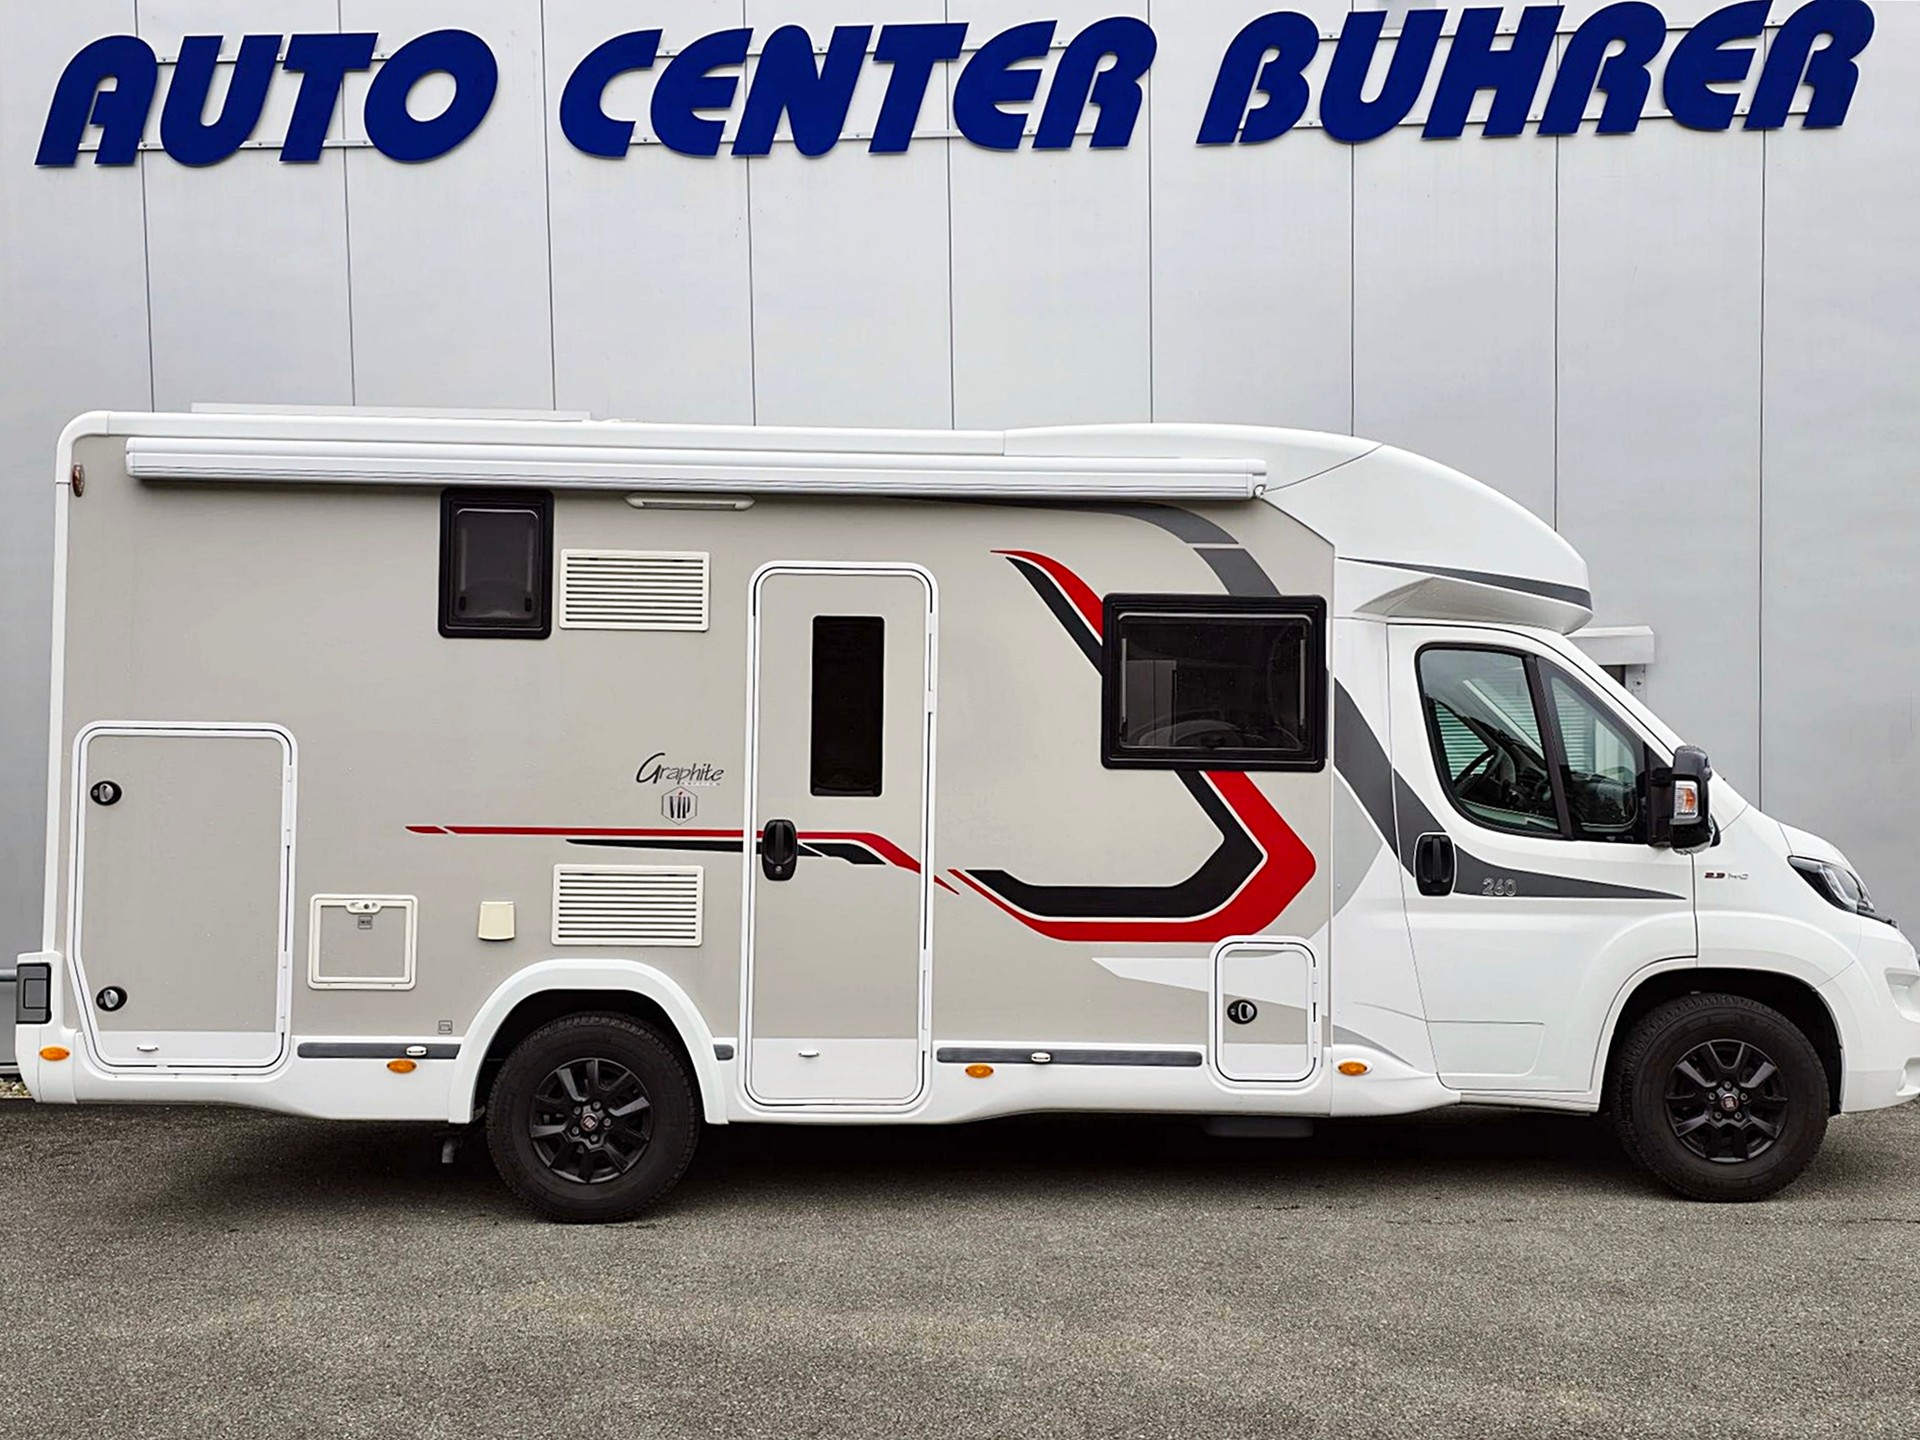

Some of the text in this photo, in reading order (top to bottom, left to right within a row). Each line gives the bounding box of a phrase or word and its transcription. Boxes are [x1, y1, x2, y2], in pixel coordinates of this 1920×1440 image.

[38, 0, 1873, 164] AUTO CENTER BUHRER
[636, 752, 725, 785] Graphite
[1482, 877, 1517, 896] 260
